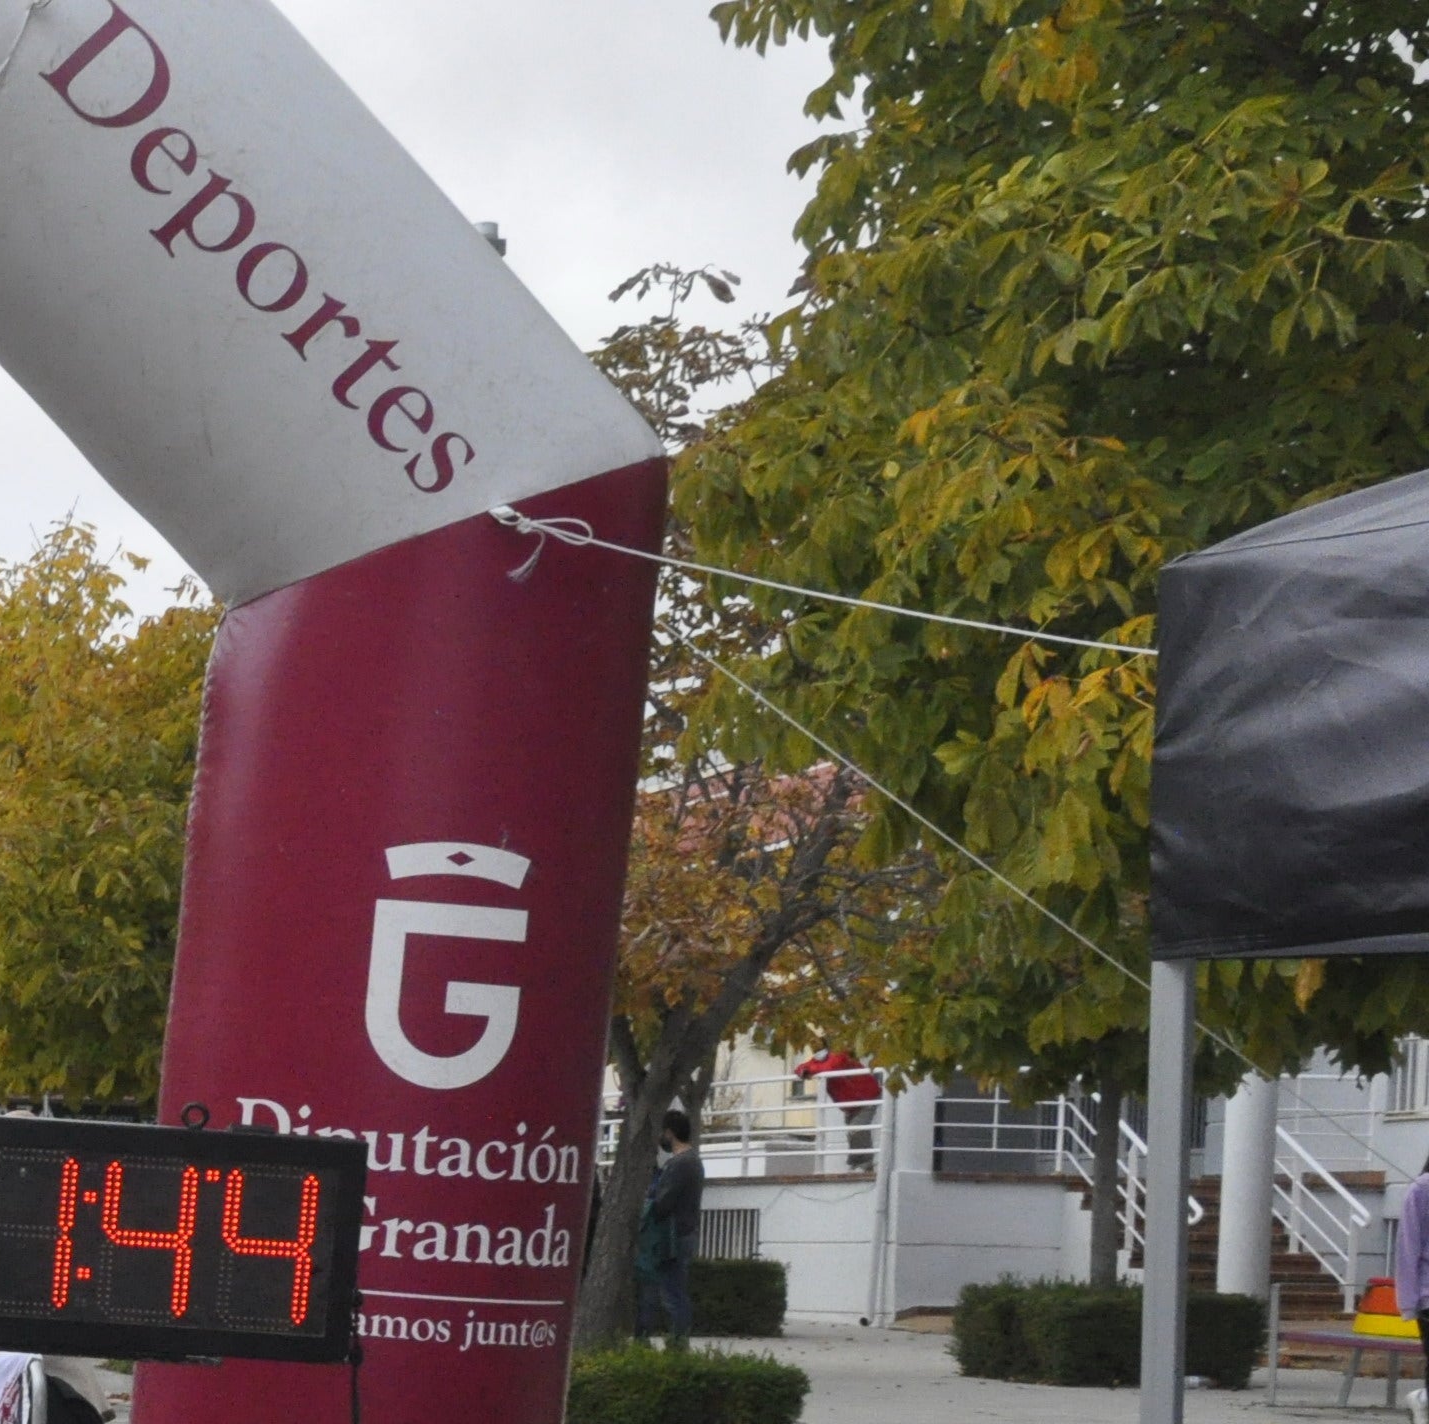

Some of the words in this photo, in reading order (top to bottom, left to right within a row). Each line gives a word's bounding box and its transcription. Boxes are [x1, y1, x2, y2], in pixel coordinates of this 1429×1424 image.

[39, 0, 475, 494] Deportes
[236, 1097, 579, 1184] Diutación
[358, 1196, 571, 1267] ranada
[459, 1312, 557, 1352] junt@s
